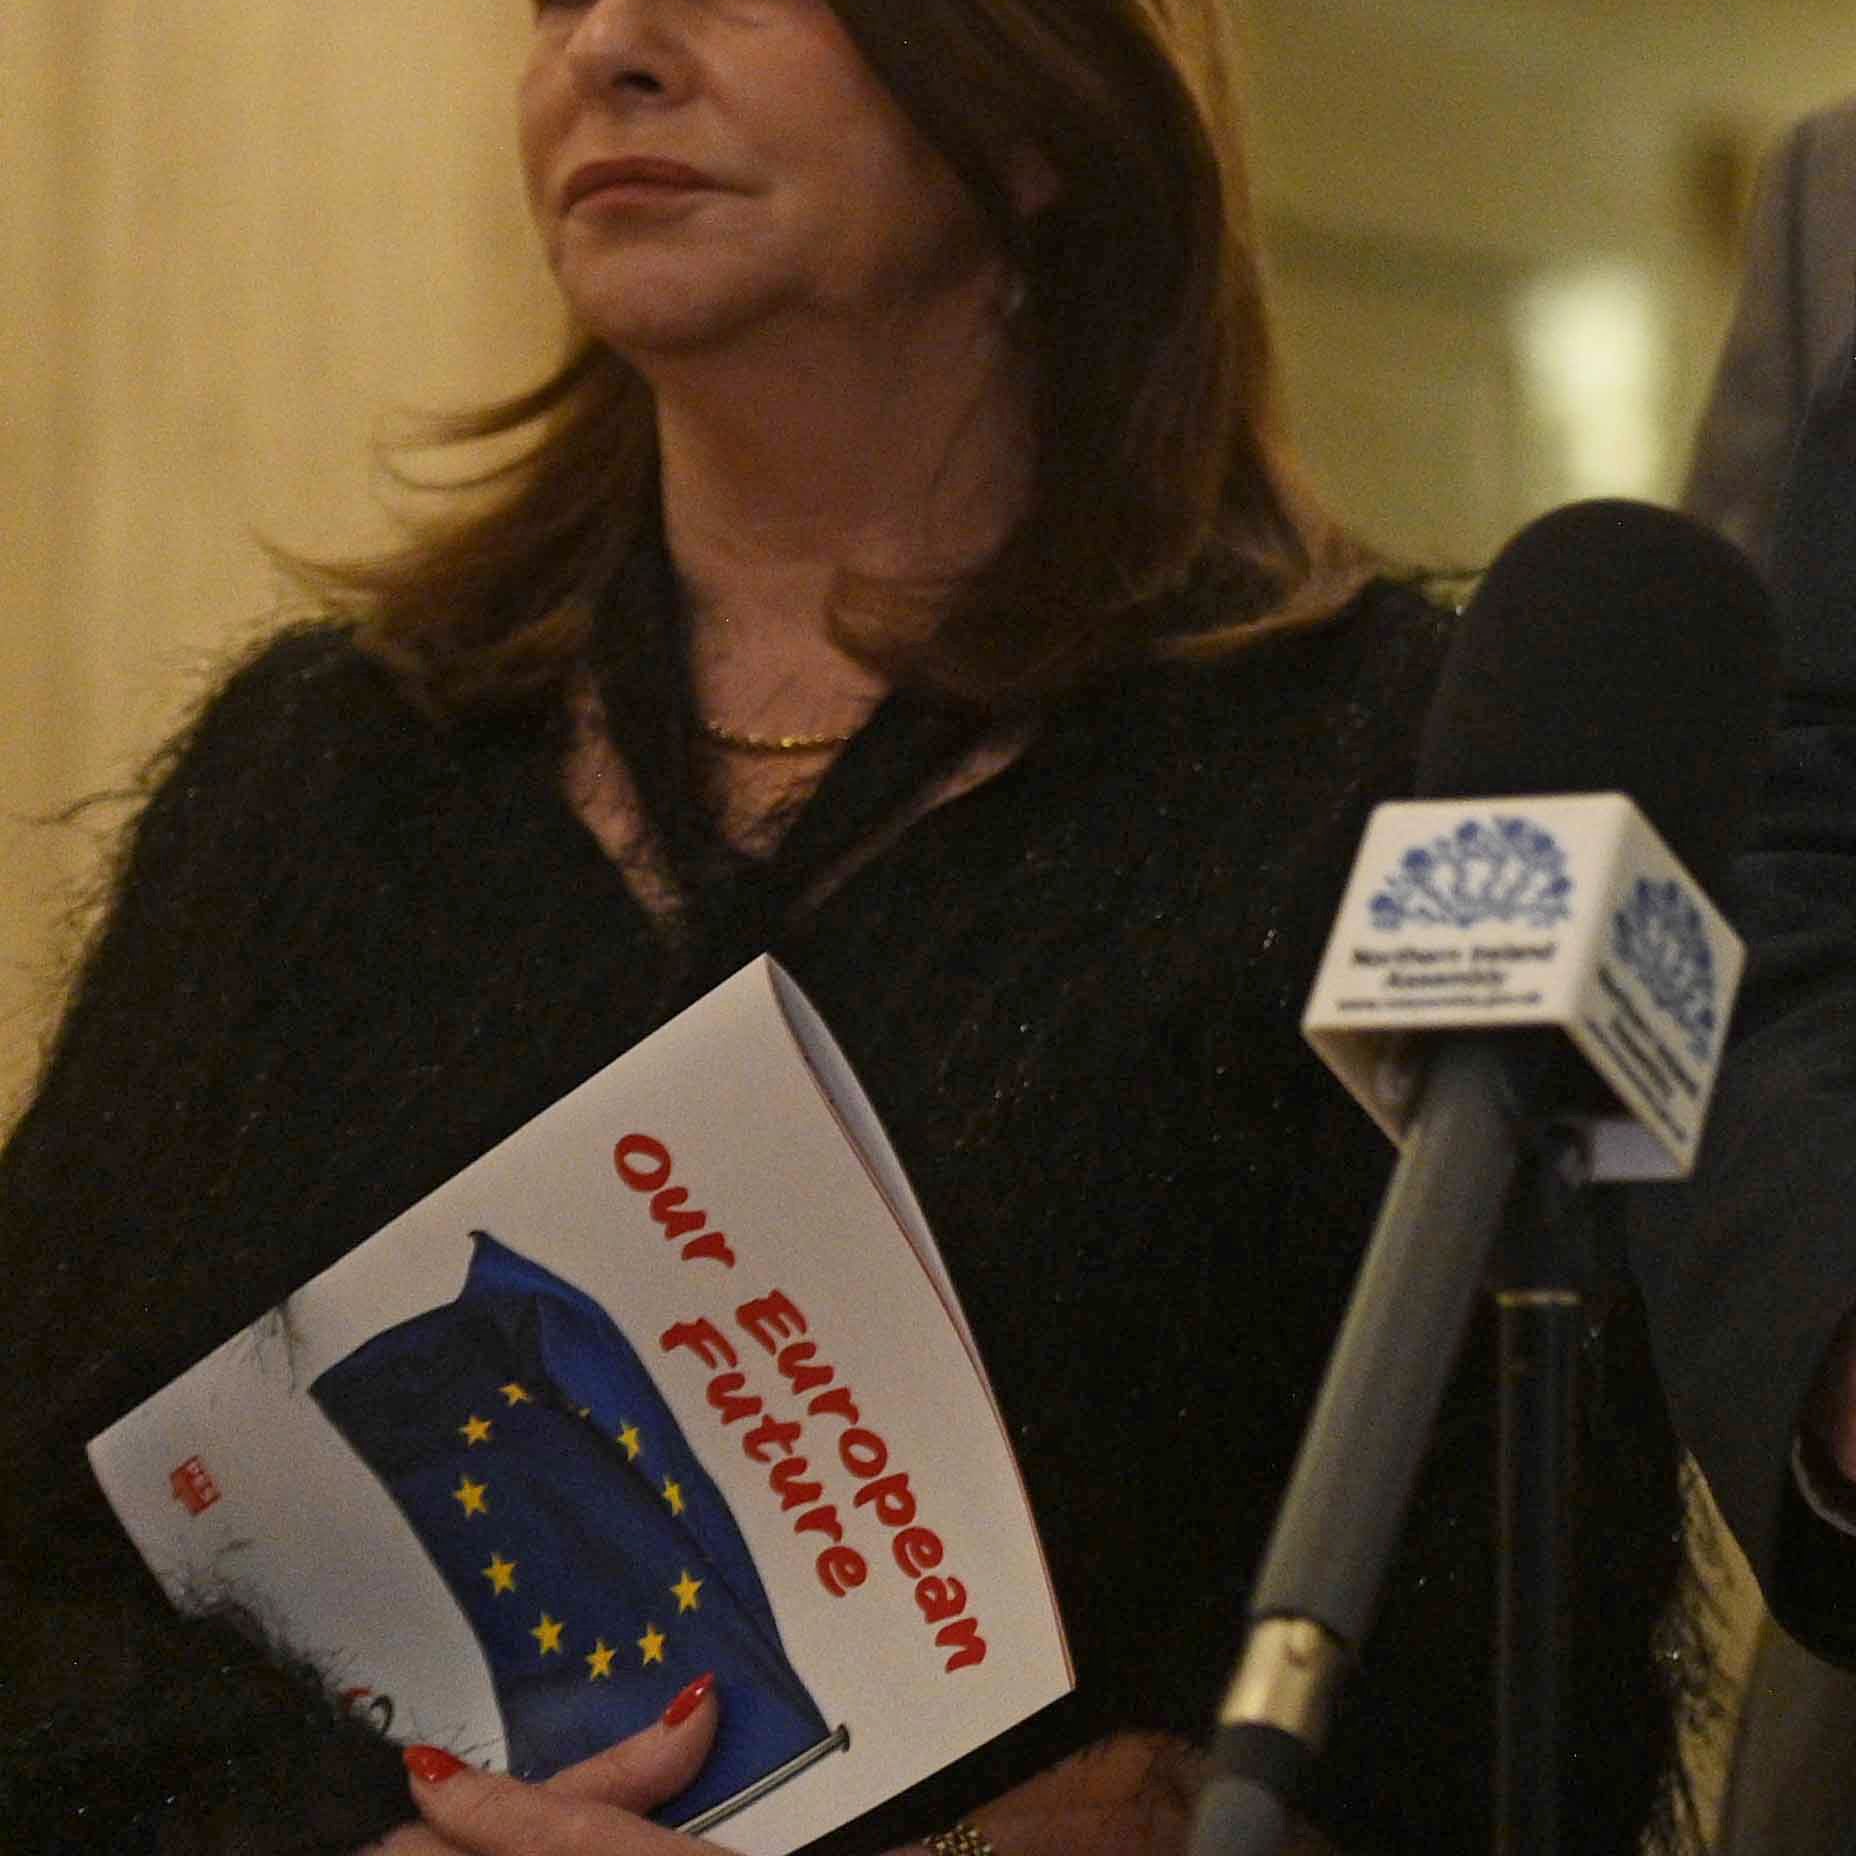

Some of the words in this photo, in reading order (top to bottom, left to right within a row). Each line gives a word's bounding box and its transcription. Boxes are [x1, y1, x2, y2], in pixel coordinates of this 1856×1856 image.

[613, 1131, 738, 1269] Our
[735, 1287, 990, 1674] European
[660, 1315, 871, 1599] Future
